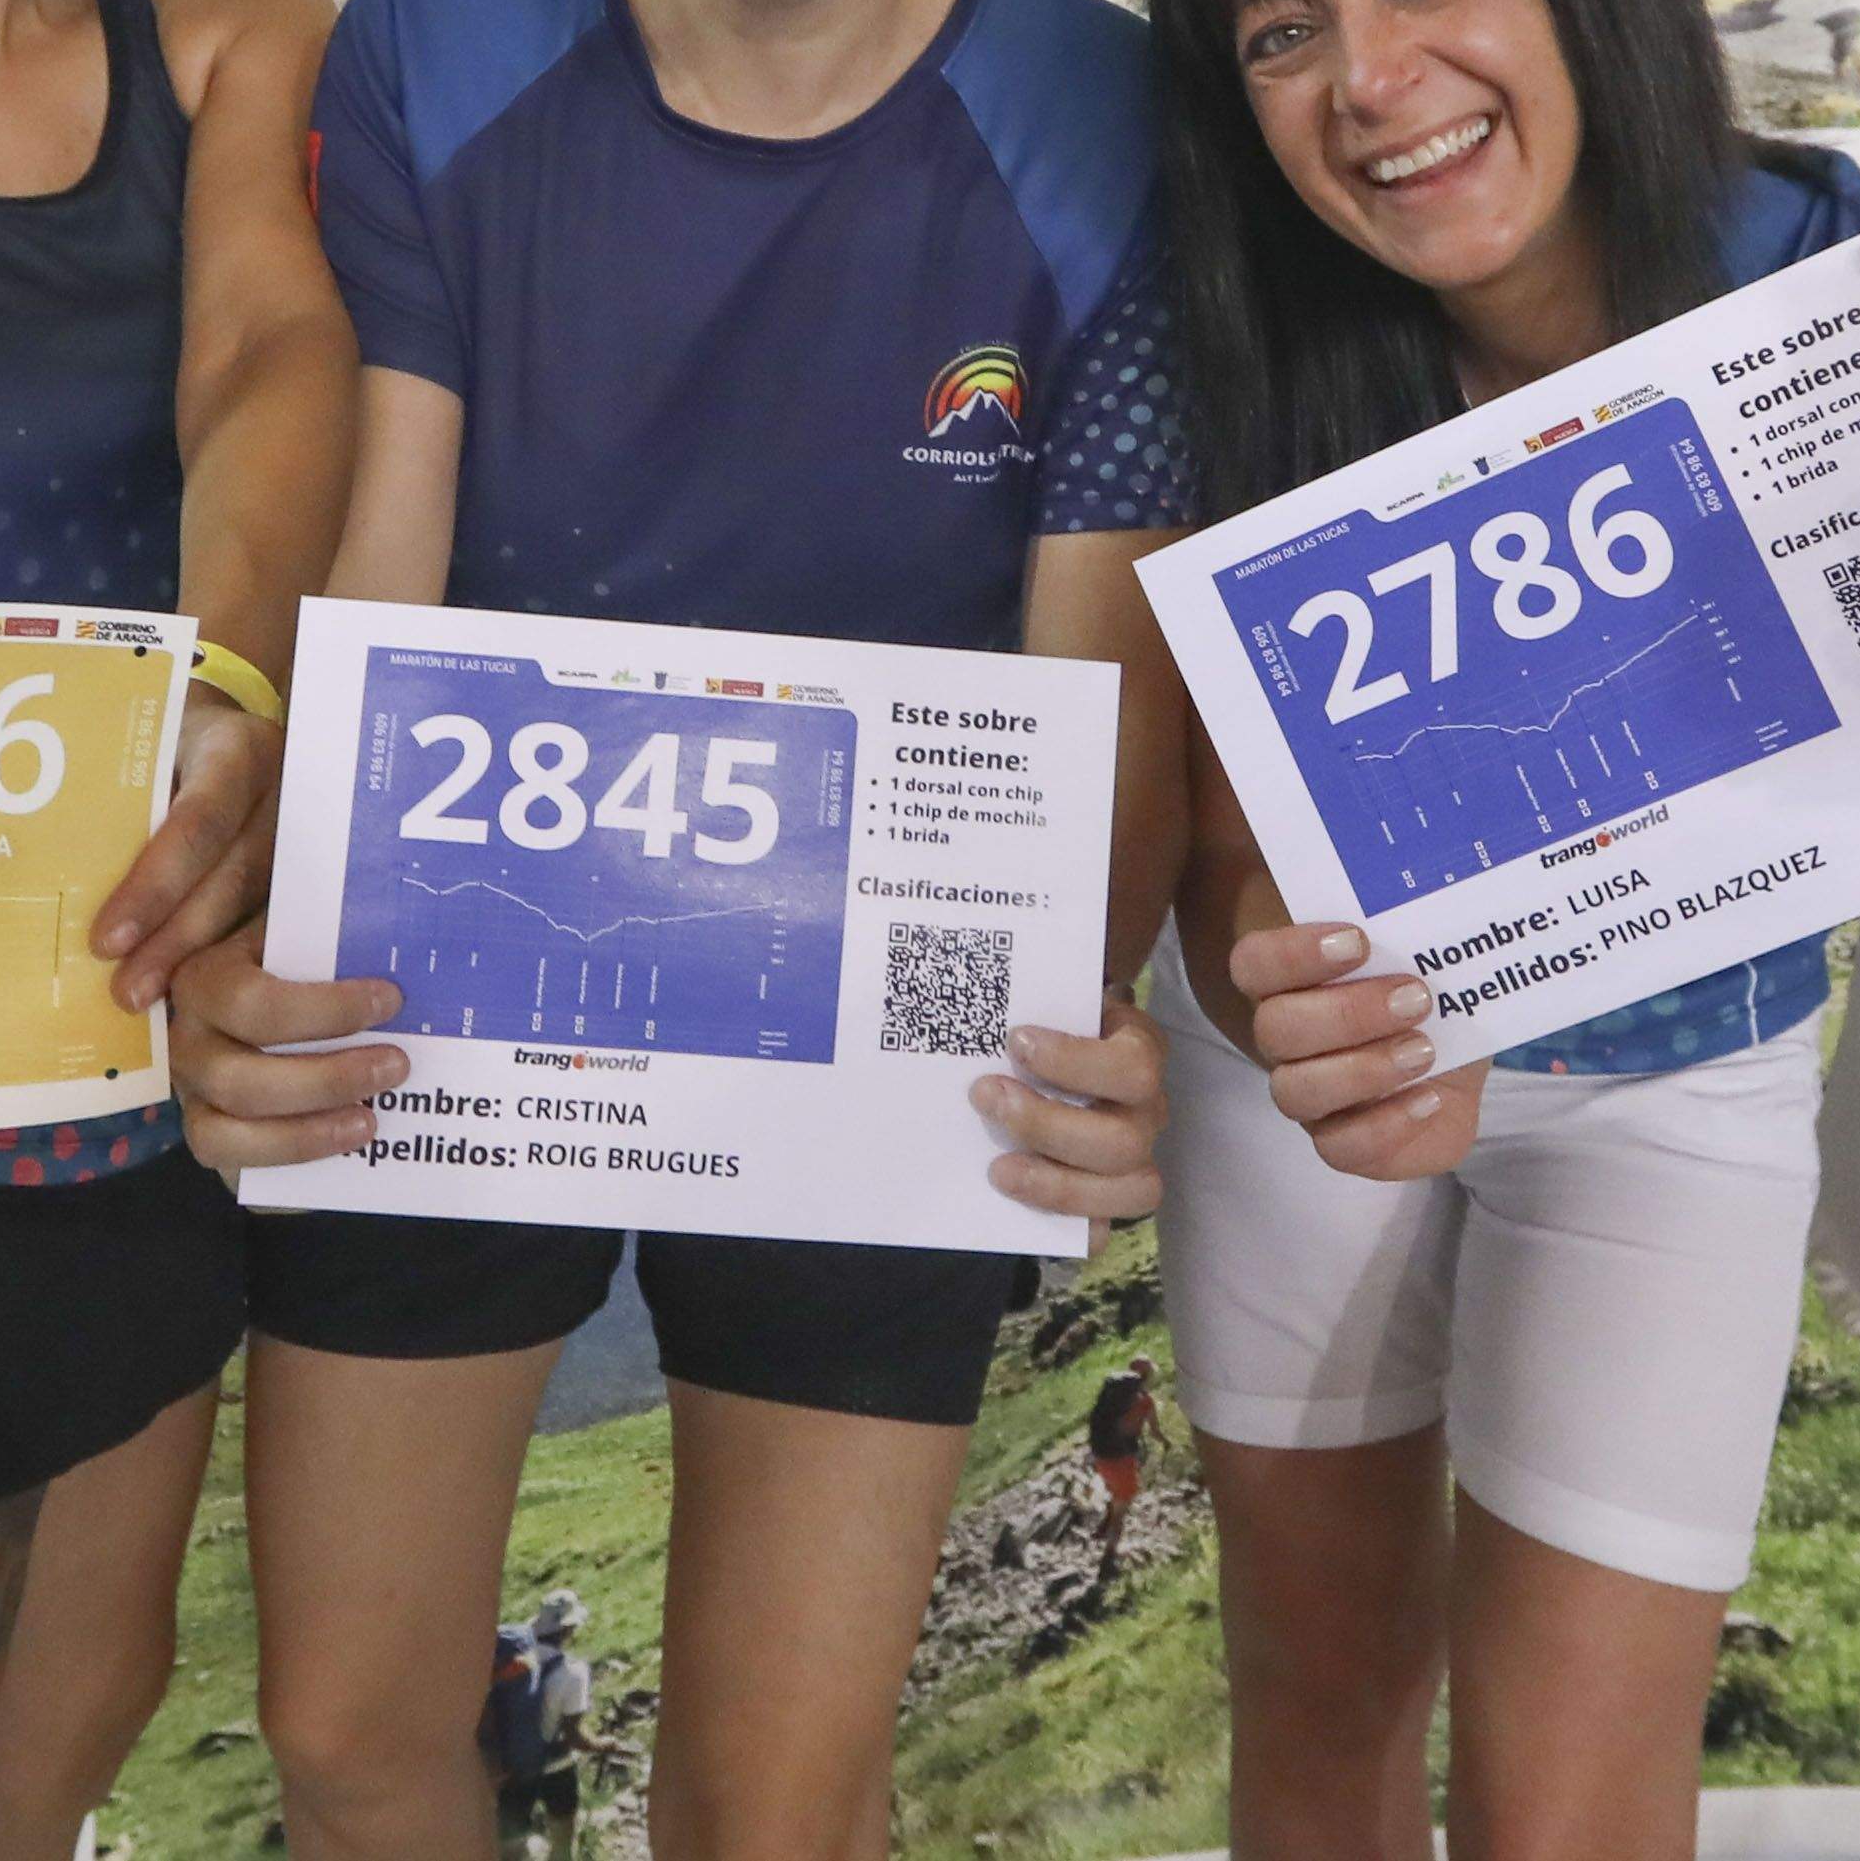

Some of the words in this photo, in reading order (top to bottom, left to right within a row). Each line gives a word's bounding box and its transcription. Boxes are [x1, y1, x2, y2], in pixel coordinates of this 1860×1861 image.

[1711, 346, 1776, 386] Este
[1749, 434, 1761, 448] 1
[1765, 405, 1825, 442] dorsal
[902, 446, 996, 467] CORRIOLS
[1678, 438, 1695, 455] 64
[1761, 457, 1771, 471] 1
[1776, 438, 1818, 465] chip
[1821, 427, 1845, 447] de
[1686, 455, 1704, 472] 98
[1772, 481, 1783, 495] 1
[1786, 459, 1840, 490] brida
[1695, 471, 1711, 489] 83
[1703, 489, 1723, 512] 606
[1234, 553, 1283, 581] MARATÓN
[1283, 545, 1297, 560] DE
[1297, 535, 1318, 553] LAS
[1316, 521, 1351, 543] TUCAS
[1287, 462, 1674, 726] 2786
[96, 631, 109, 641] DE
[98, 620, 156, 633] GOBIERNO
[1251, 625, 1270, 648] 606
[389, 653, 440, 669] MARATÓN
[444, 657, 457, 670] DE
[460, 659, 481, 672] LAS
[482, 661, 517, 675] TUCAS
[1262, 648, 1277, 664] 83
[1268, 664, 1285, 681] 98
[1277, 680, 1292, 697] 64
[892, 702, 950, 726] Este
[958, 709, 1037, 733] sobre
[895, 744, 1029, 773] contiene:
[399, 713, 780, 865] 2845
[891, 777, 899, 790] 1
[905, 778, 962, 796] dorsal
[968, 784, 1000, 799] con
[1005, 785, 1044, 806] chip
[890, 802, 897, 815] 1
[903, 802, 942, 822] chip
[947, 806, 969, 821] de
[975, 810, 1047, 827] mochila
[888, 827, 896, 840] 1
[902, 827, 950, 845] brida
[1540, 803, 1670, 870] trangoworld
[857, 876, 1037, 907] Clasificaciones
[1413, 904, 1561, 976] Nombre:
[1567, 868, 1652, 916] LUISA
[1438, 941, 1599, 1019] Apellidos:
[1599, 907, 1672, 952] PINO
[1676, 845, 1827, 920] BLAZQUEZ
[514, 1047, 650, 1073] trangoworld
[517, 1096, 648, 1126] CRISTINA
[527, 1142, 598, 1169] ROIG
[608, 1147, 740, 1178] BRUGUES
